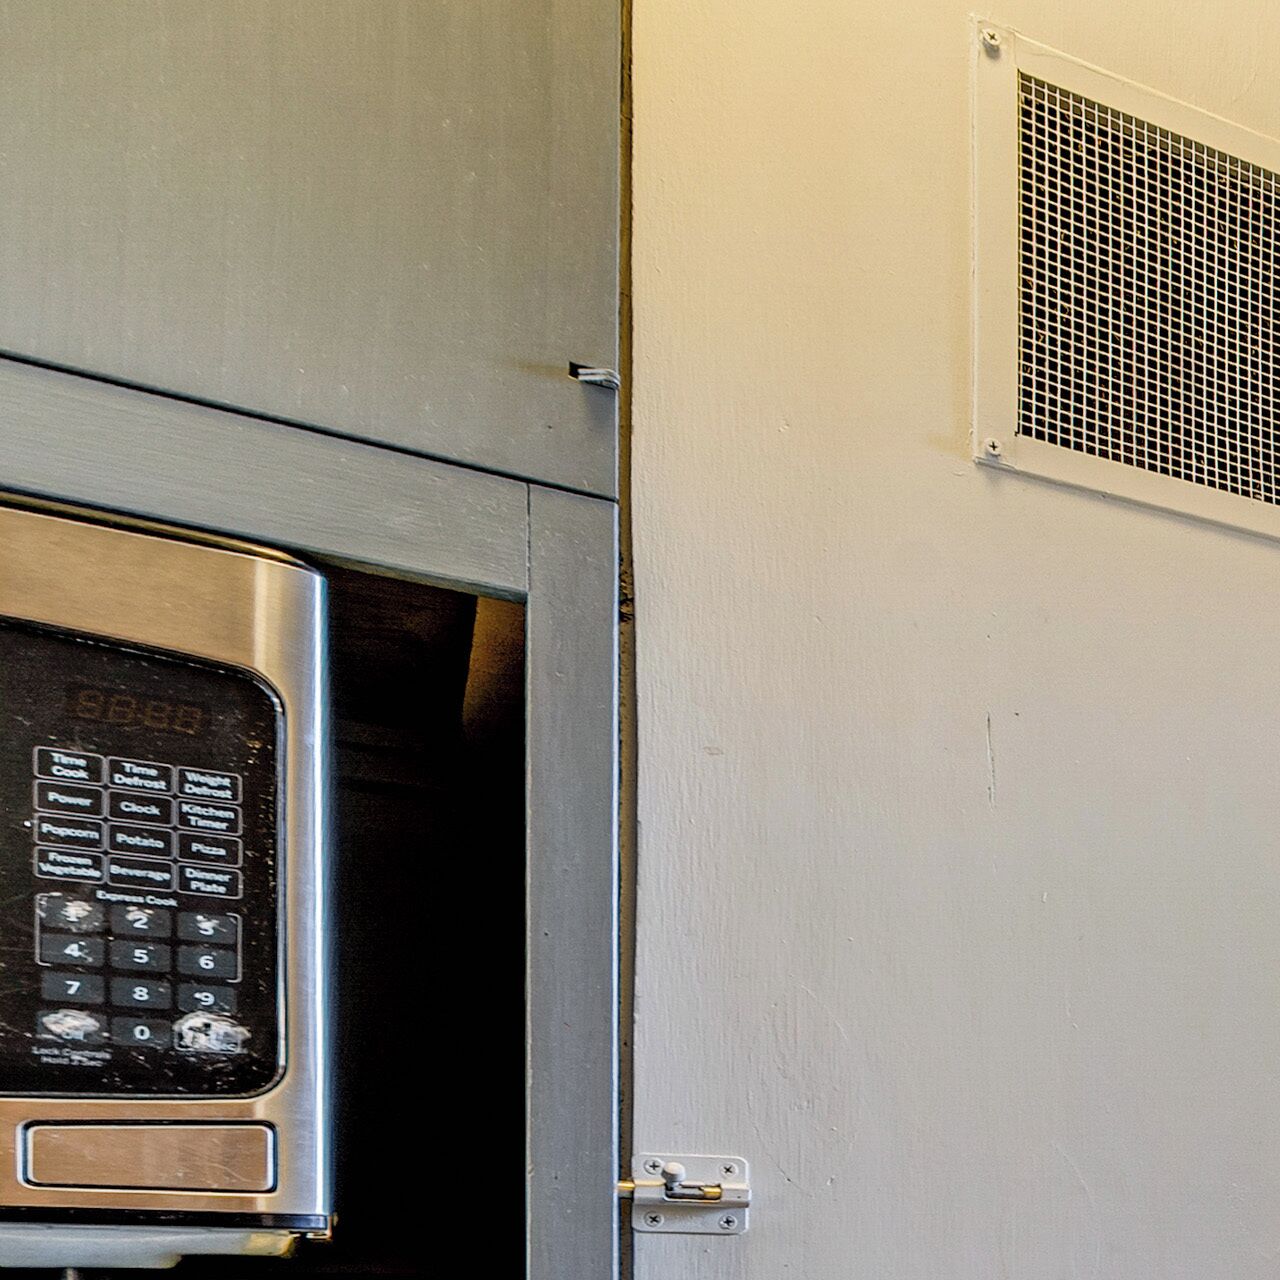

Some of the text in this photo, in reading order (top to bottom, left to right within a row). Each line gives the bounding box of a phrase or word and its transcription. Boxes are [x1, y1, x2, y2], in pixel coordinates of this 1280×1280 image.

[50, 752, 87, 768] Time
[51, 765, 89, 780] Cook
[121, 762, 159, 777] Time
[113, 773, 168, 791] Defrost
[185, 771, 232, 788] Weight
[184, 783, 233, 799] Defrost
[48, 791, 93, 807] Power
[120, 801, 160, 816] Clock
[181, 803, 235, 819] Kitchen
[41, 822, 99, 840] Popcorn
[187, 816, 229, 831] Timer
[116, 832, 165, 848] Potato
[191, 842, 226, 856] Pizza
[48, 852, 93, 866] Frozen
[38, 862, 102, 878] Vegetable
[110, 864, 171, 881] Beverage
[185, 867, 232, 882] Dinner
[190, 880, 227, 894] Plate
[96, 890, 178, 907] Express Cook
[132, 914, 149, 929] 2
[63, 943, 80, 958] 4
[132, 948, 149, 964] 5
[199, 955, 215, 970] 6
[64, 980, 81, 995] 7
[132, 986, 150, 1001] 8
[199, 991, 216, 1006] 9
[133, 1025, 151, 1041] 0
